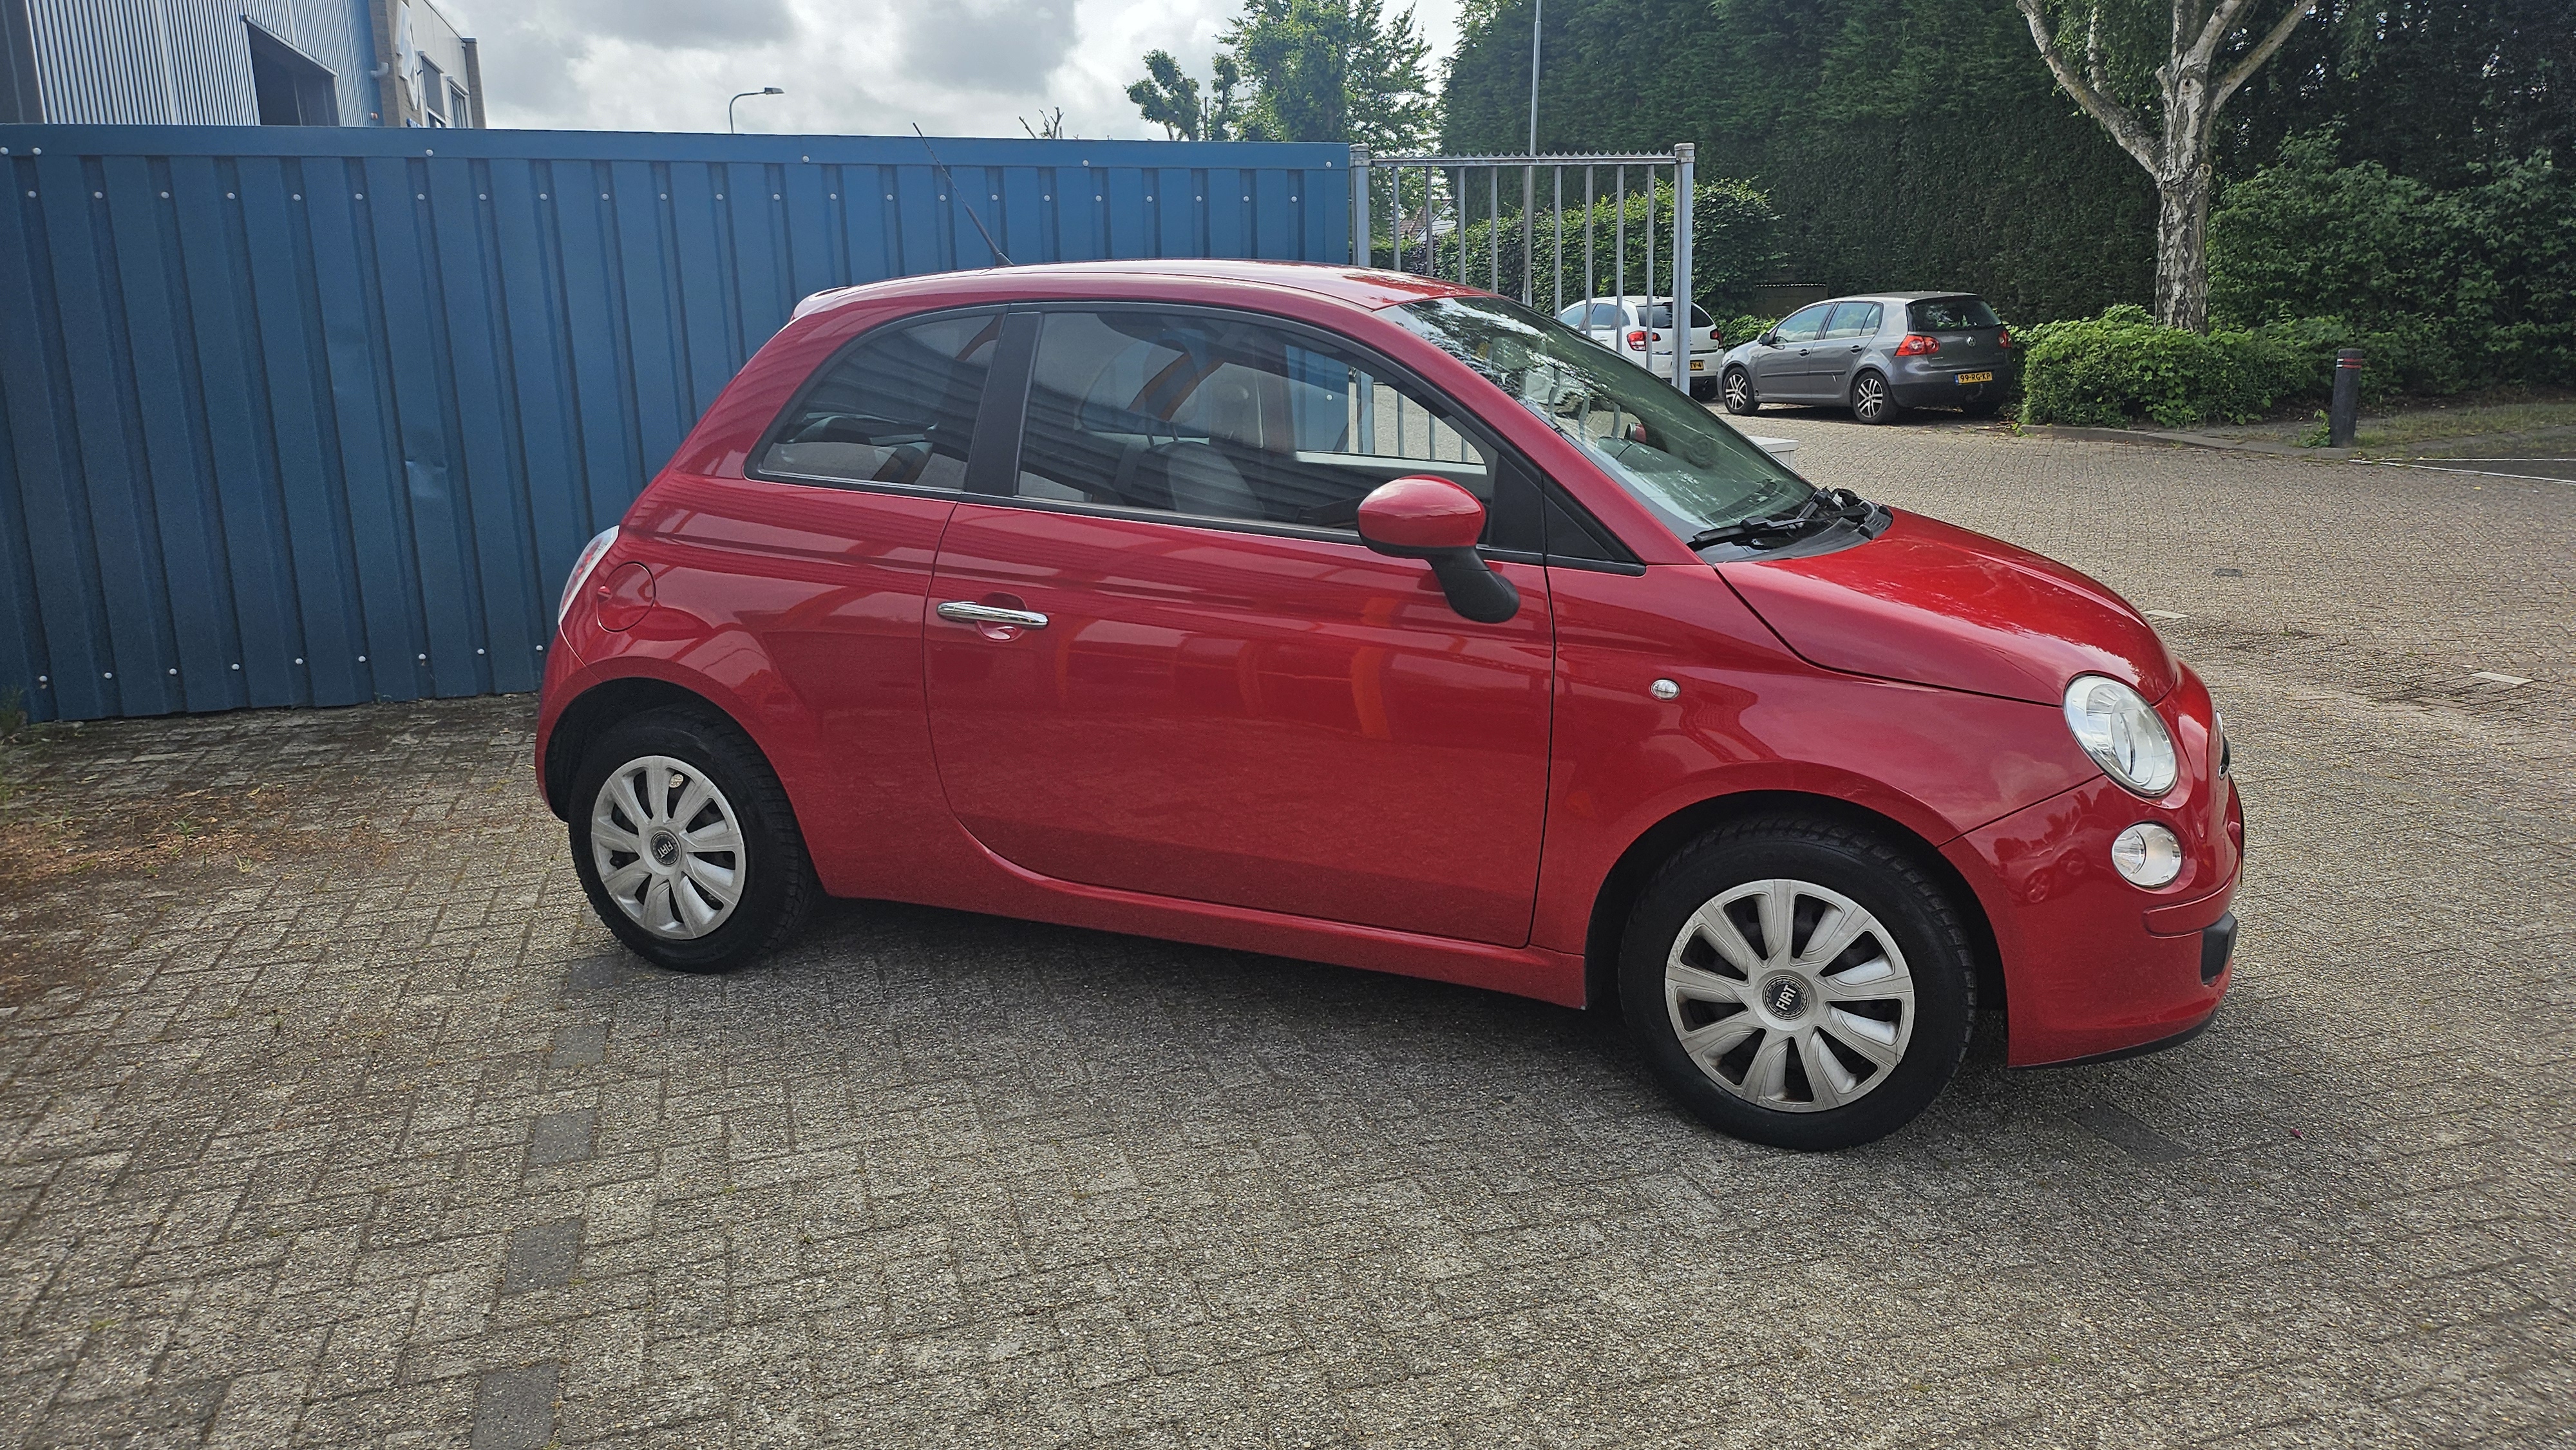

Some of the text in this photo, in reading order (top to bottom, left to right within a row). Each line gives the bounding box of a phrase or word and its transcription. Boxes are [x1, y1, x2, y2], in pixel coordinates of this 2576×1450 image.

[1960, 372, 1991, 382] 99-RG-KP
[658, 840, 674, 858] FIAT
[1776, 984, 1797, 1011] FIAT
